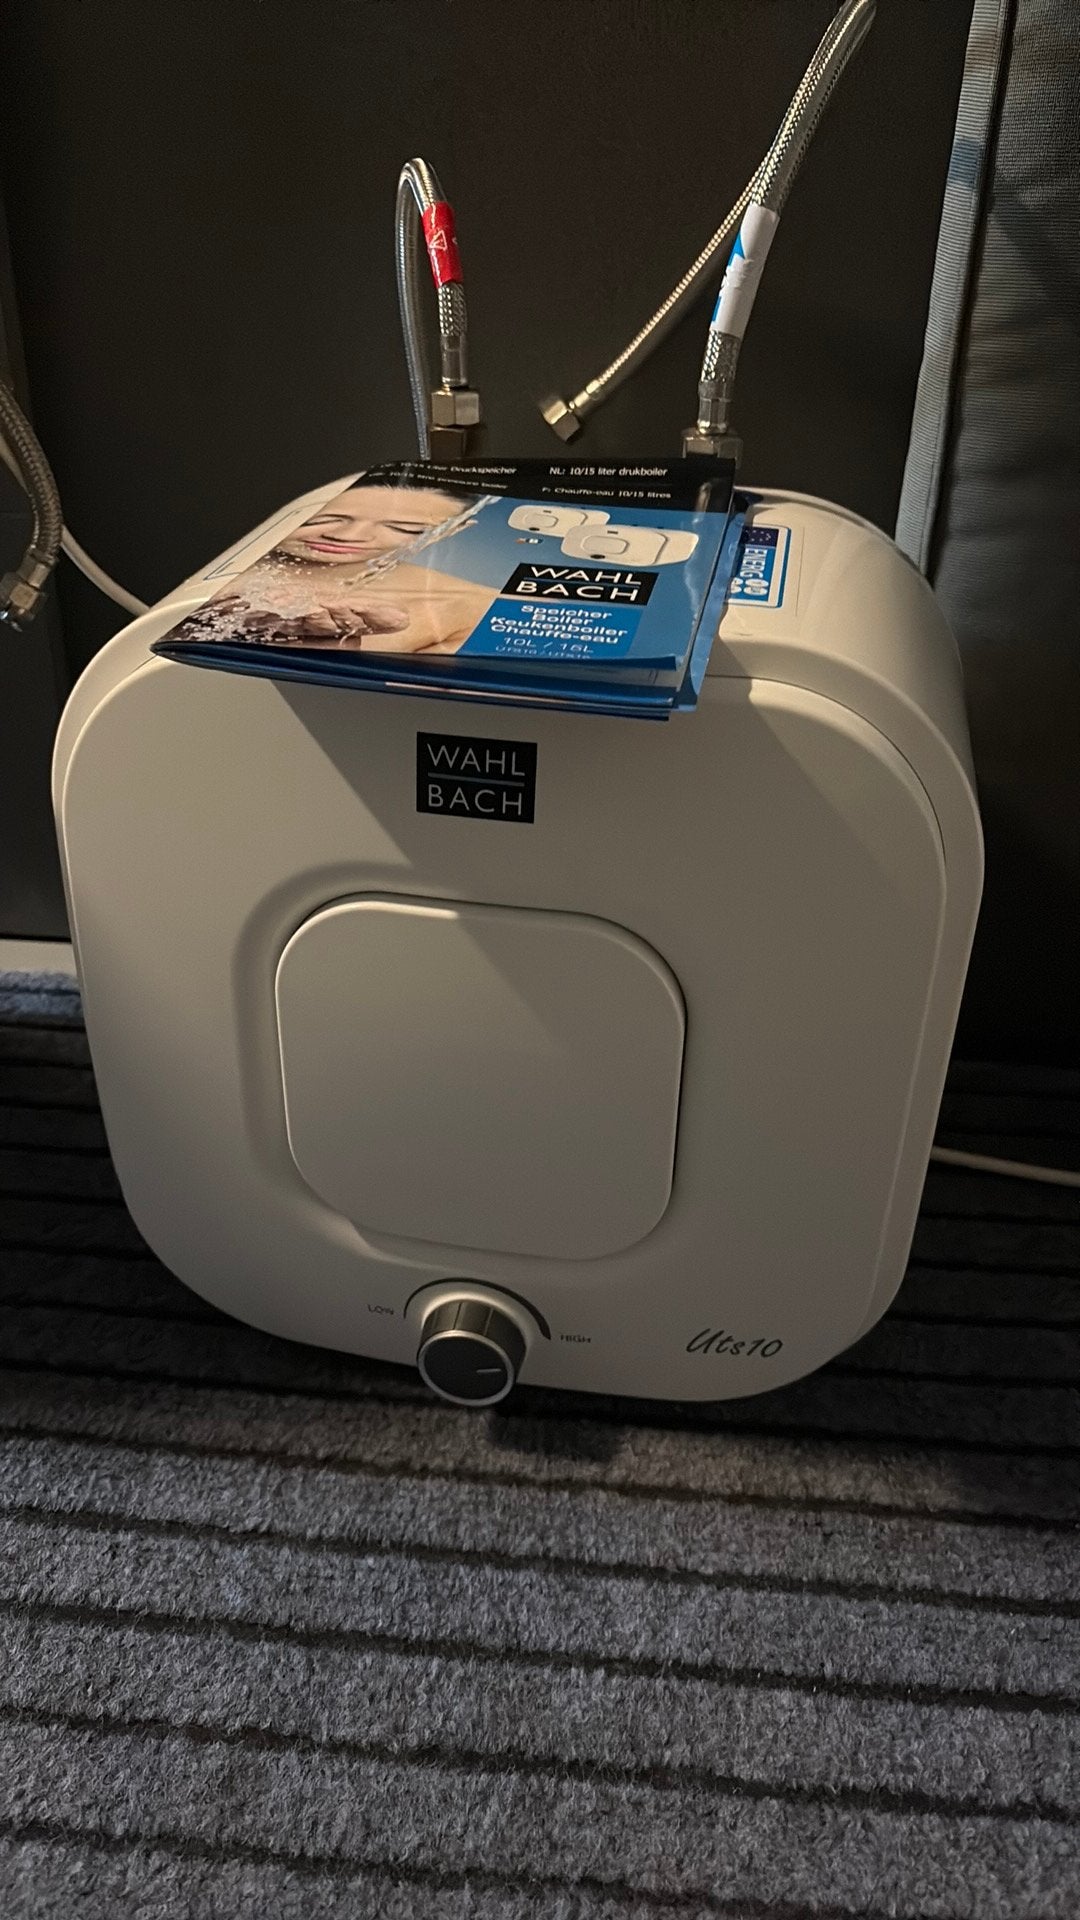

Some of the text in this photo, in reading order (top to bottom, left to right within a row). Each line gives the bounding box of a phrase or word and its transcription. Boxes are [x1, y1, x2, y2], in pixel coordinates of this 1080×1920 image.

[450, 466, 517, 474] Druckspeicher
[549, 467, 668, 476] NL: 10/15 liter drukboiler
[554, 487, 614, 496] Chauffe-eau
[619, 490, 644, 498] 10/15
[740, 548, 767, 578] ENERG
[530, 566, 642, 585] WAHL
[516, 580, 640, 602] BACH
[521, 605, 612, 619] Speicher
[532, 614, 593, 625] Boiler
[490, 616, 628, 636] Keukenboiler
[491, 624, 619, 644] Chauffe-eau
[504, 637, 536, 647] 10L
[427, 743, 525, 776] WAHL
[428, 784, 522, 816] BACH
[367, 1304, 394, 1315] LOW
[560, 1334, 591, 1343] HIGH
[686, 1328, 783, 1358] Uts10
